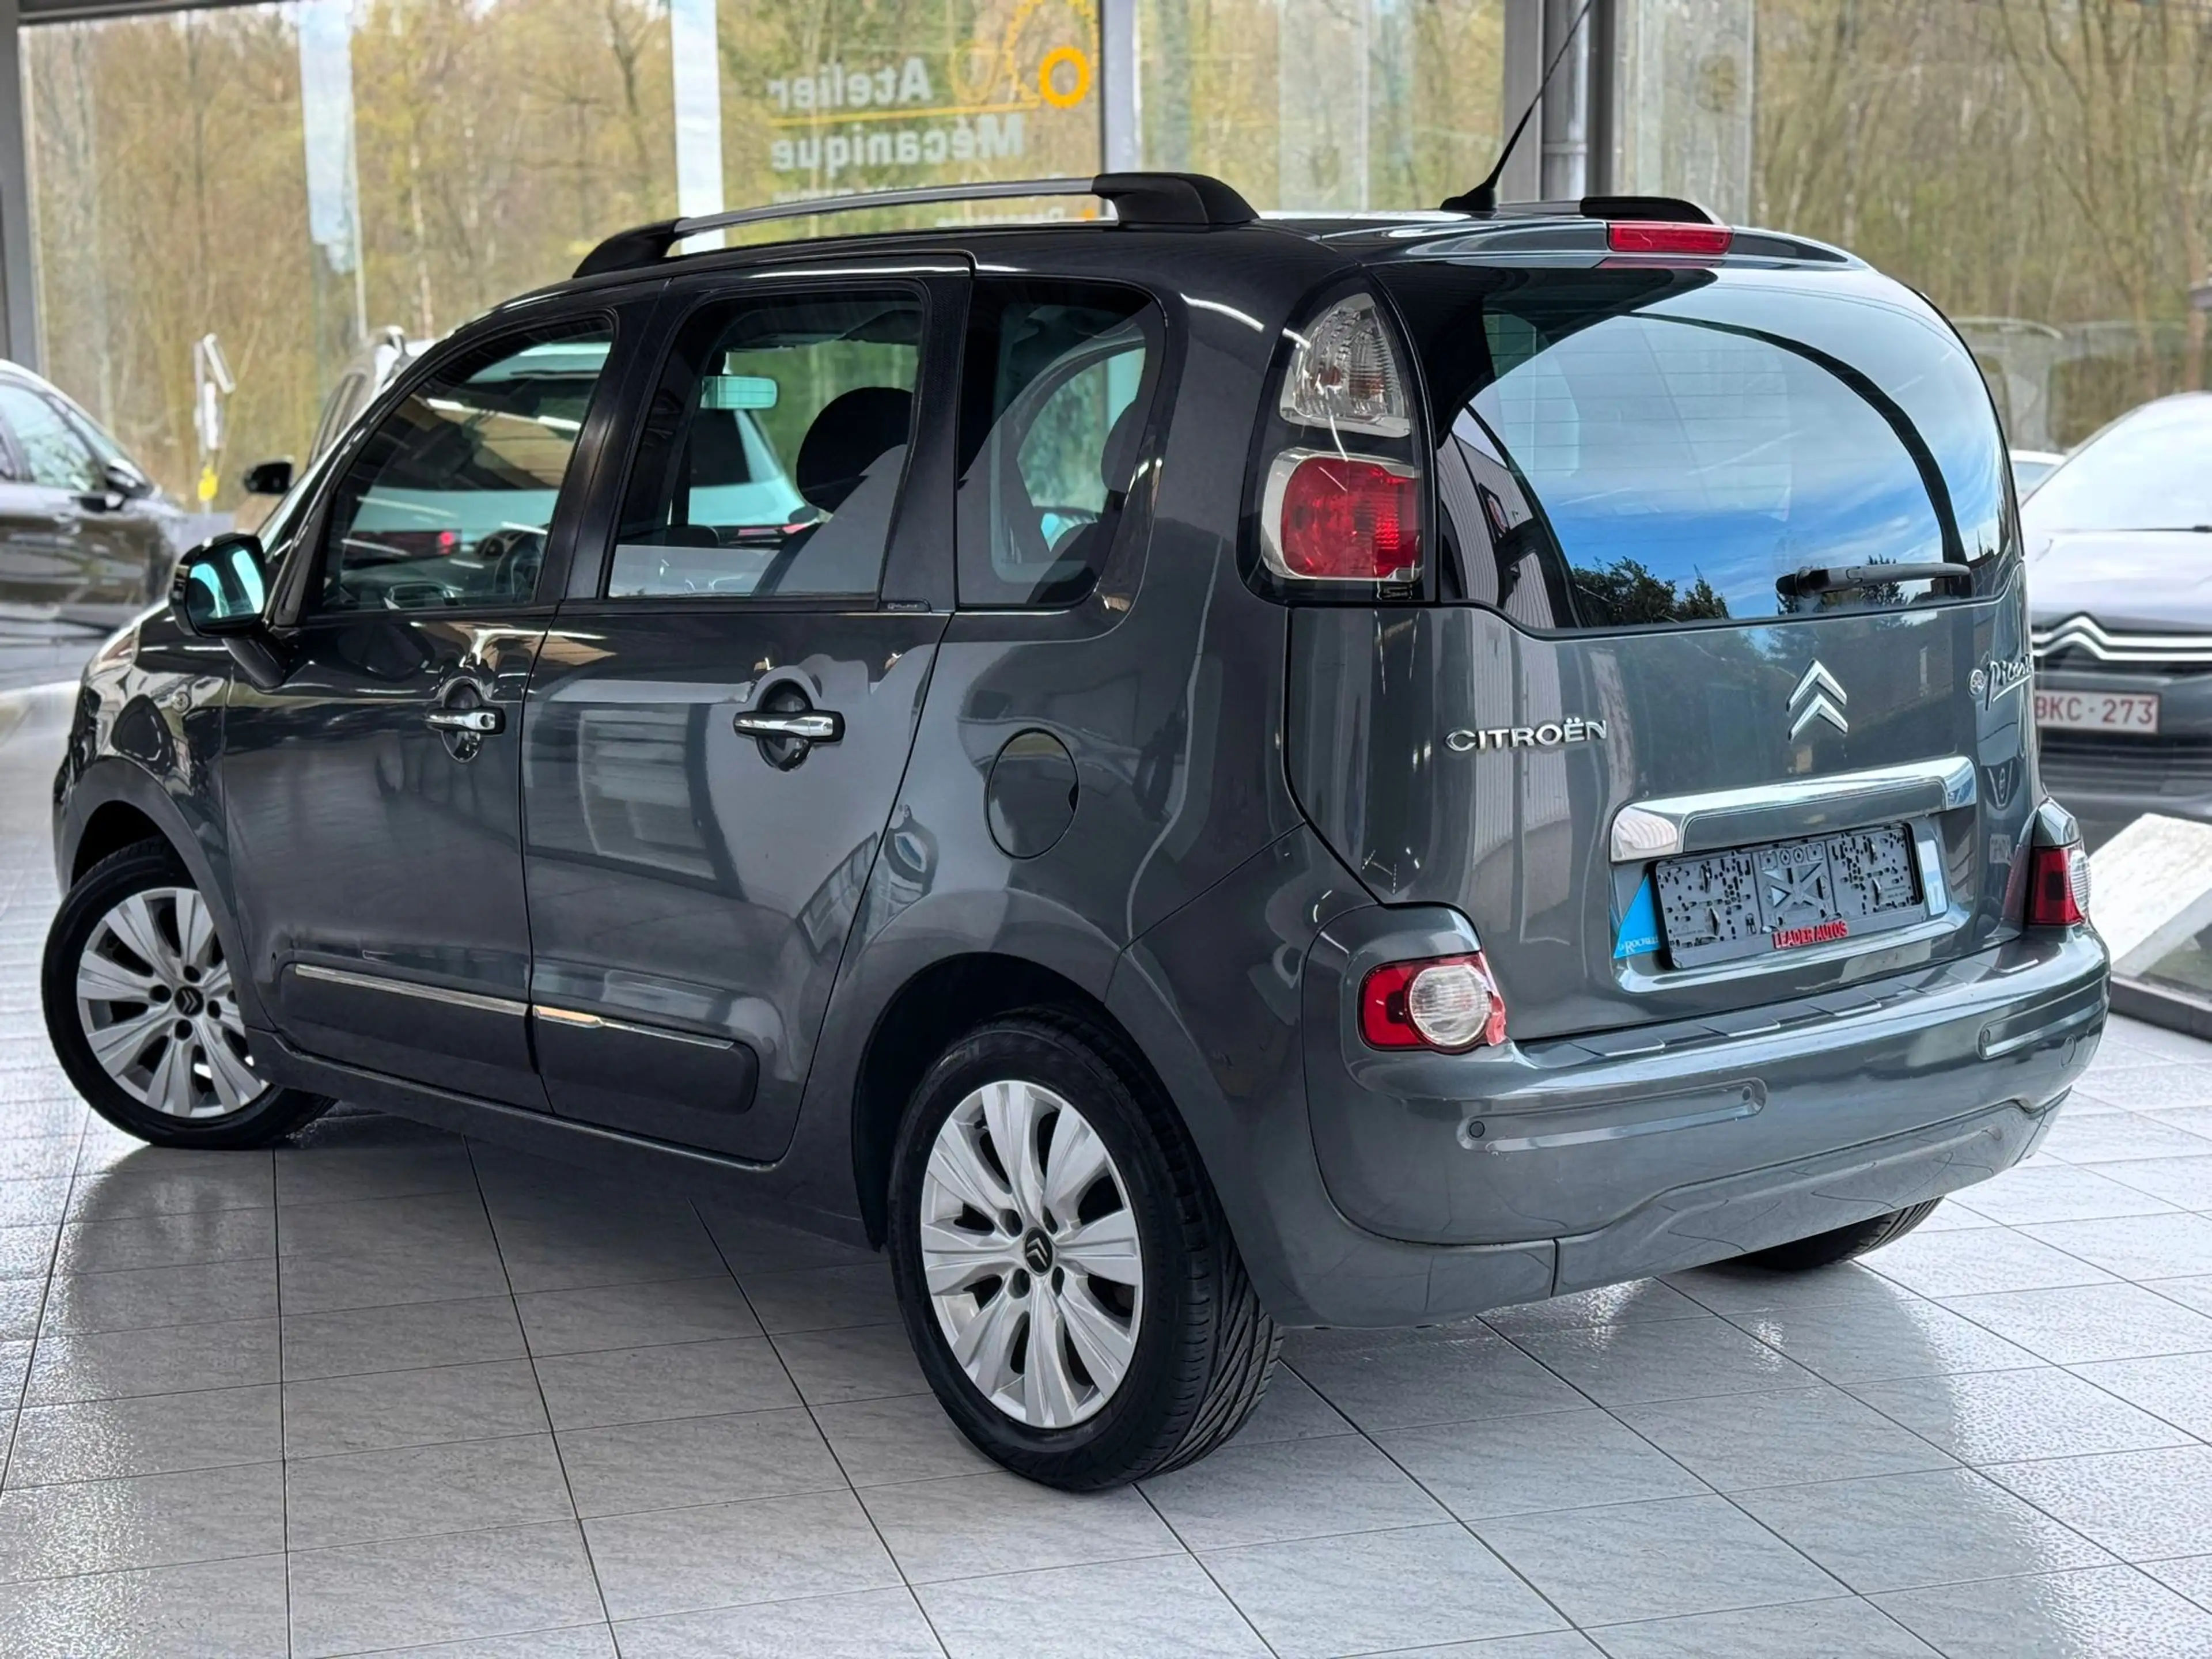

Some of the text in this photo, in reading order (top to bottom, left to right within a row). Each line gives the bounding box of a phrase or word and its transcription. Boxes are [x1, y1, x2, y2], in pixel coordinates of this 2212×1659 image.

[1445, 717, 1607, 751] CITROËN
[1772, 921, 1848, 949] LEADER AUTOS
